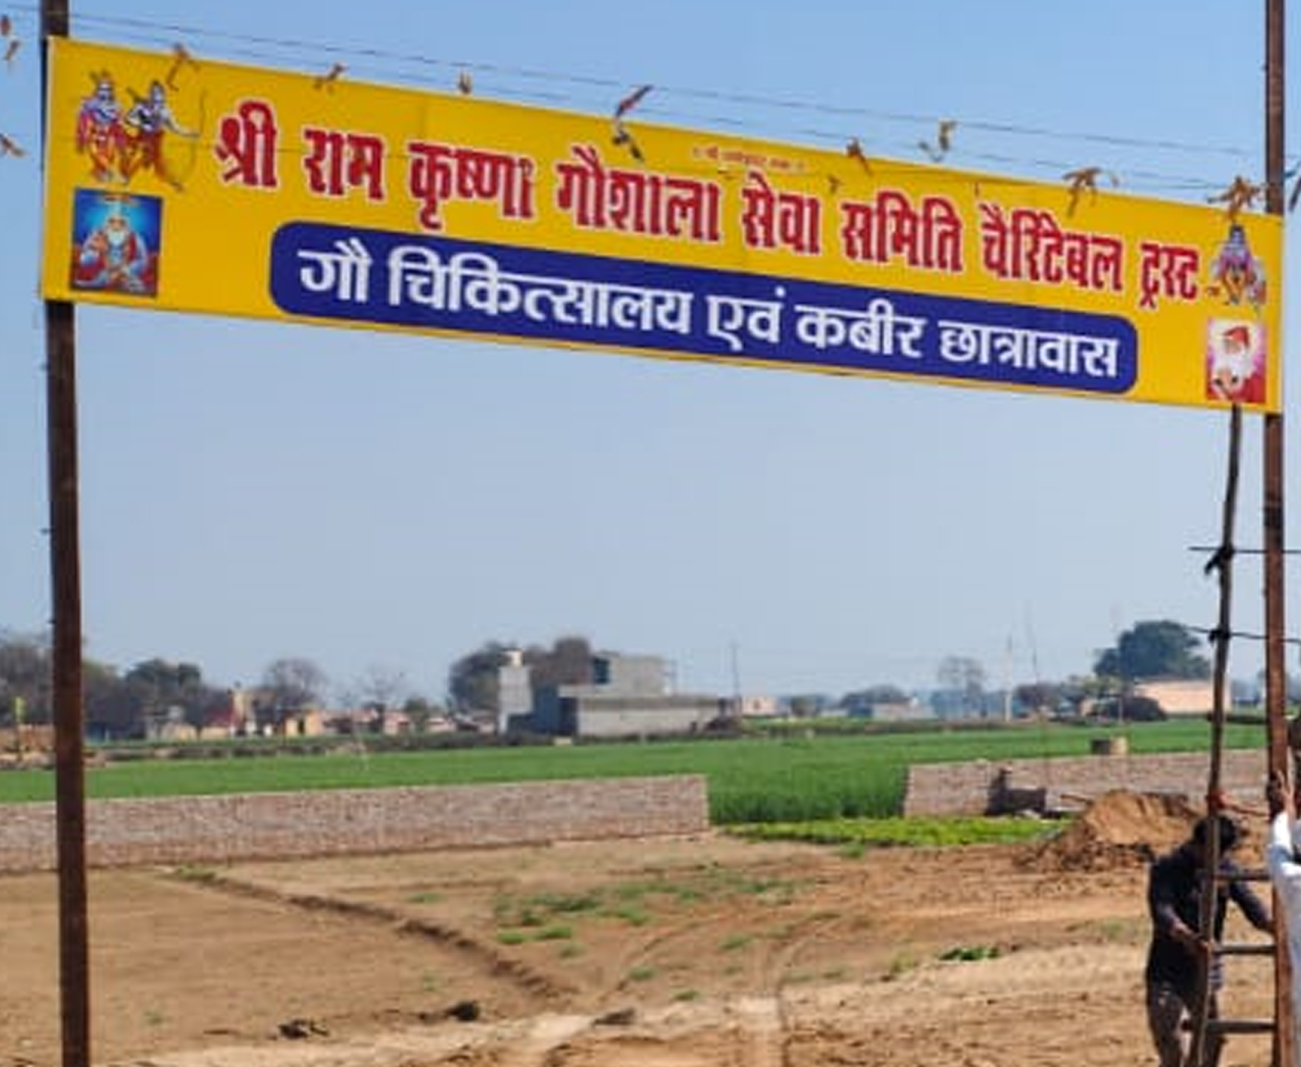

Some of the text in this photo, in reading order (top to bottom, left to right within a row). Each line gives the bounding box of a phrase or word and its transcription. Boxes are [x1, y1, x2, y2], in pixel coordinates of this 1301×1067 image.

[213, 97, 280, 189] श्री
[302, 126, 385, 201] राम
[406, 141, 534, 231] कृष्णा
[555, 144, 722, 242] गौशाला
[741, 168, 821, 255] सेवा
[840, 188, 964, 272] समिति
[1139, 242, 1199, 309] ट्रस्ट
[297, 237, 1119, 378] गौ चिकित्सालय एवं कबीर छात्रावास
